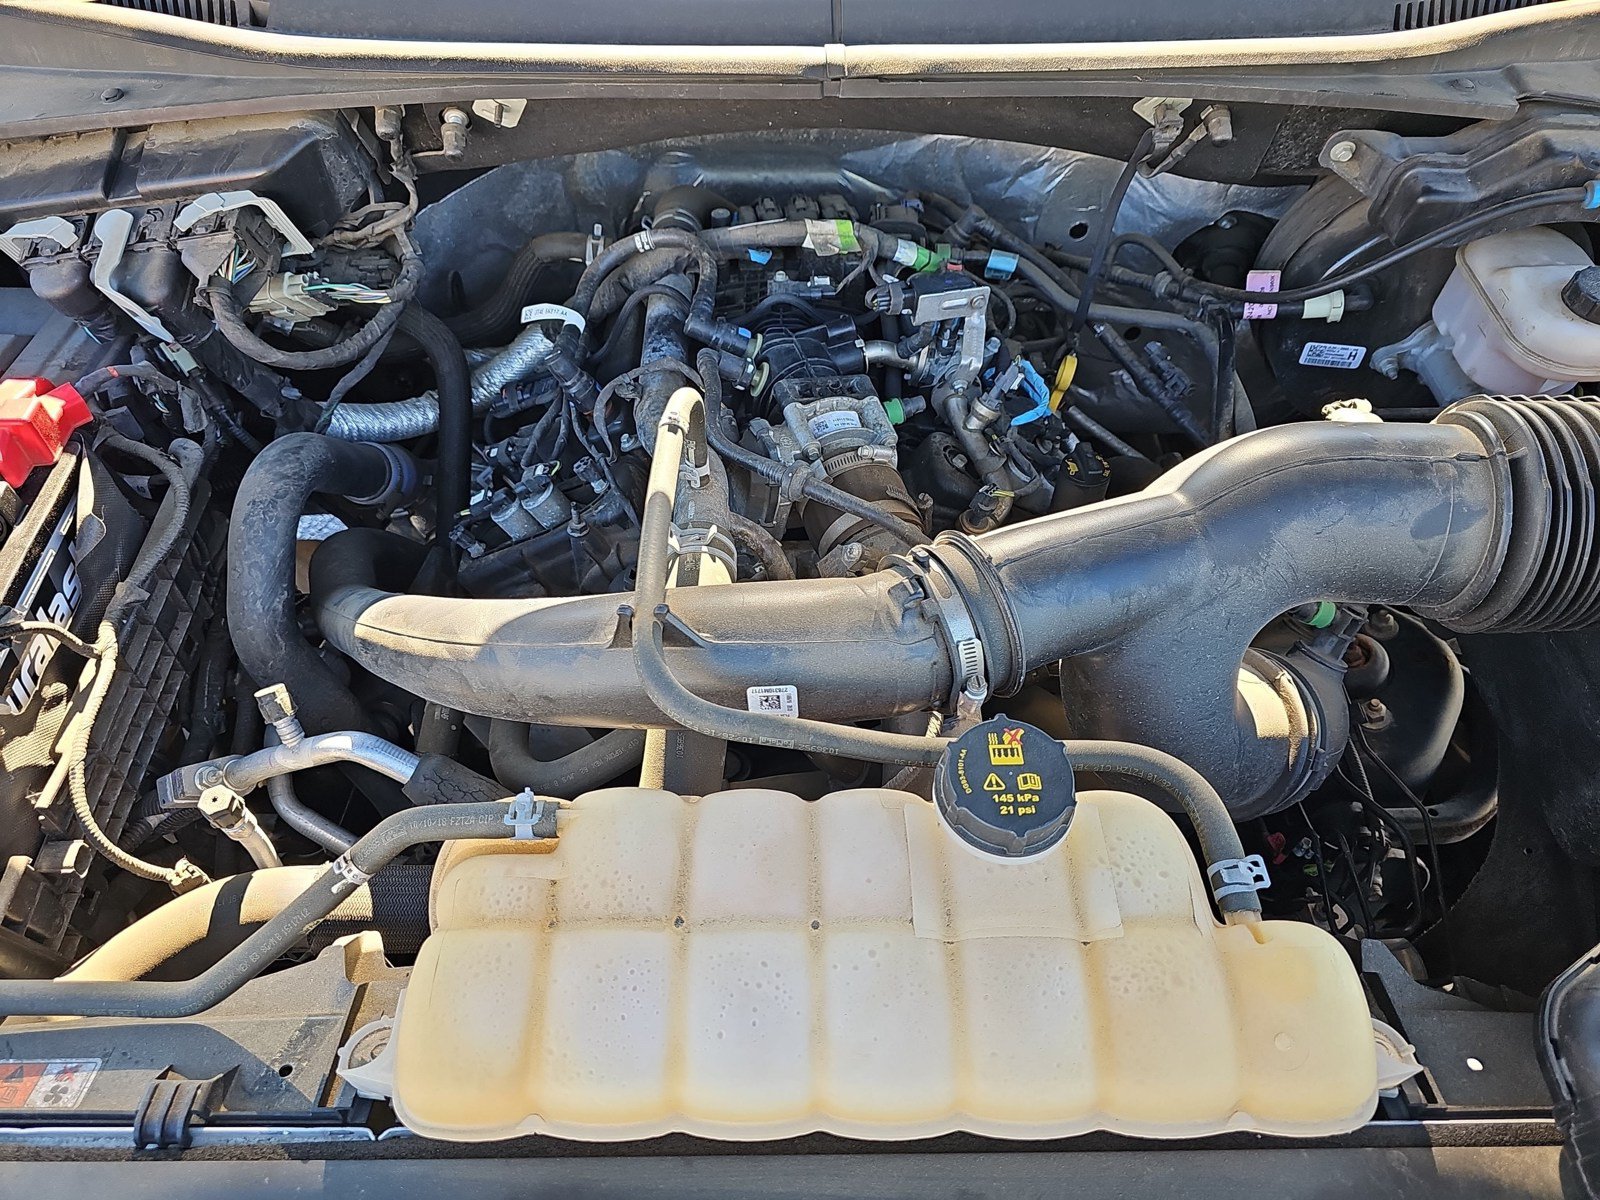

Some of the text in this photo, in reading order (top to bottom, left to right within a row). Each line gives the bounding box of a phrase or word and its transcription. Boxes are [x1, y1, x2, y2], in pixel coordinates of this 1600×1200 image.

[1347, 351, 1358, 361] H
[6, 541, 82, 714] uralas
[798, 743, 839, 755] 1036952
[1116, 766, 1144, 778] FZTZA
[1147, 771, 1182, 800] 10/26/18
[992, 793, 1040, 803] 145 kPa
[1000, 804, 1036, 816] 21 psi
[410, 818, 447, 830] 10/10/18
[450, 815, 476, 827] FZTZA
[478, 814, 495, 825] CIP
